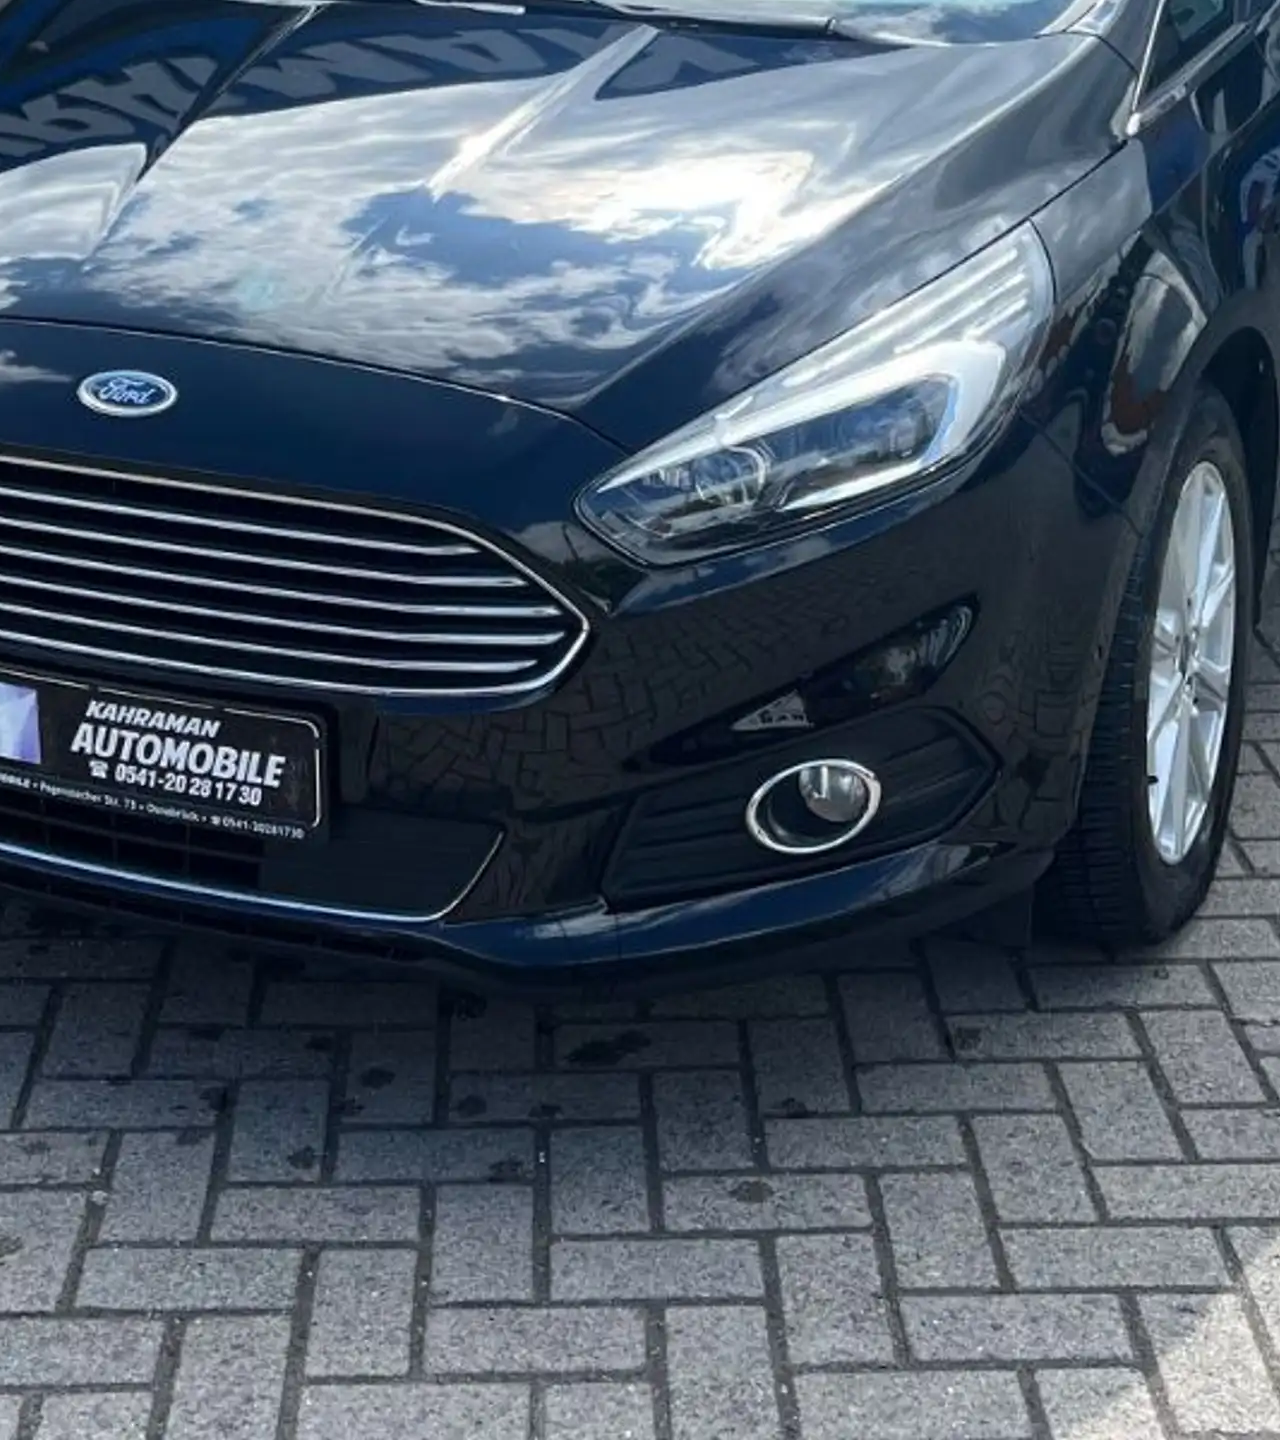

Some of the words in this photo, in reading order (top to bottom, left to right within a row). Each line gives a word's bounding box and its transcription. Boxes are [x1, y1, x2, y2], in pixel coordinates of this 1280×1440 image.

[98, 377, 157, 405] Ford
[85, 699, 221, 738] KAHRAMAN
[70, 722, 286, 788] AUTOMOBILE
[188, 777, 211, 798] 28
[216, 781, 238, 801] 17
[238, 786, 263, 807] 30
